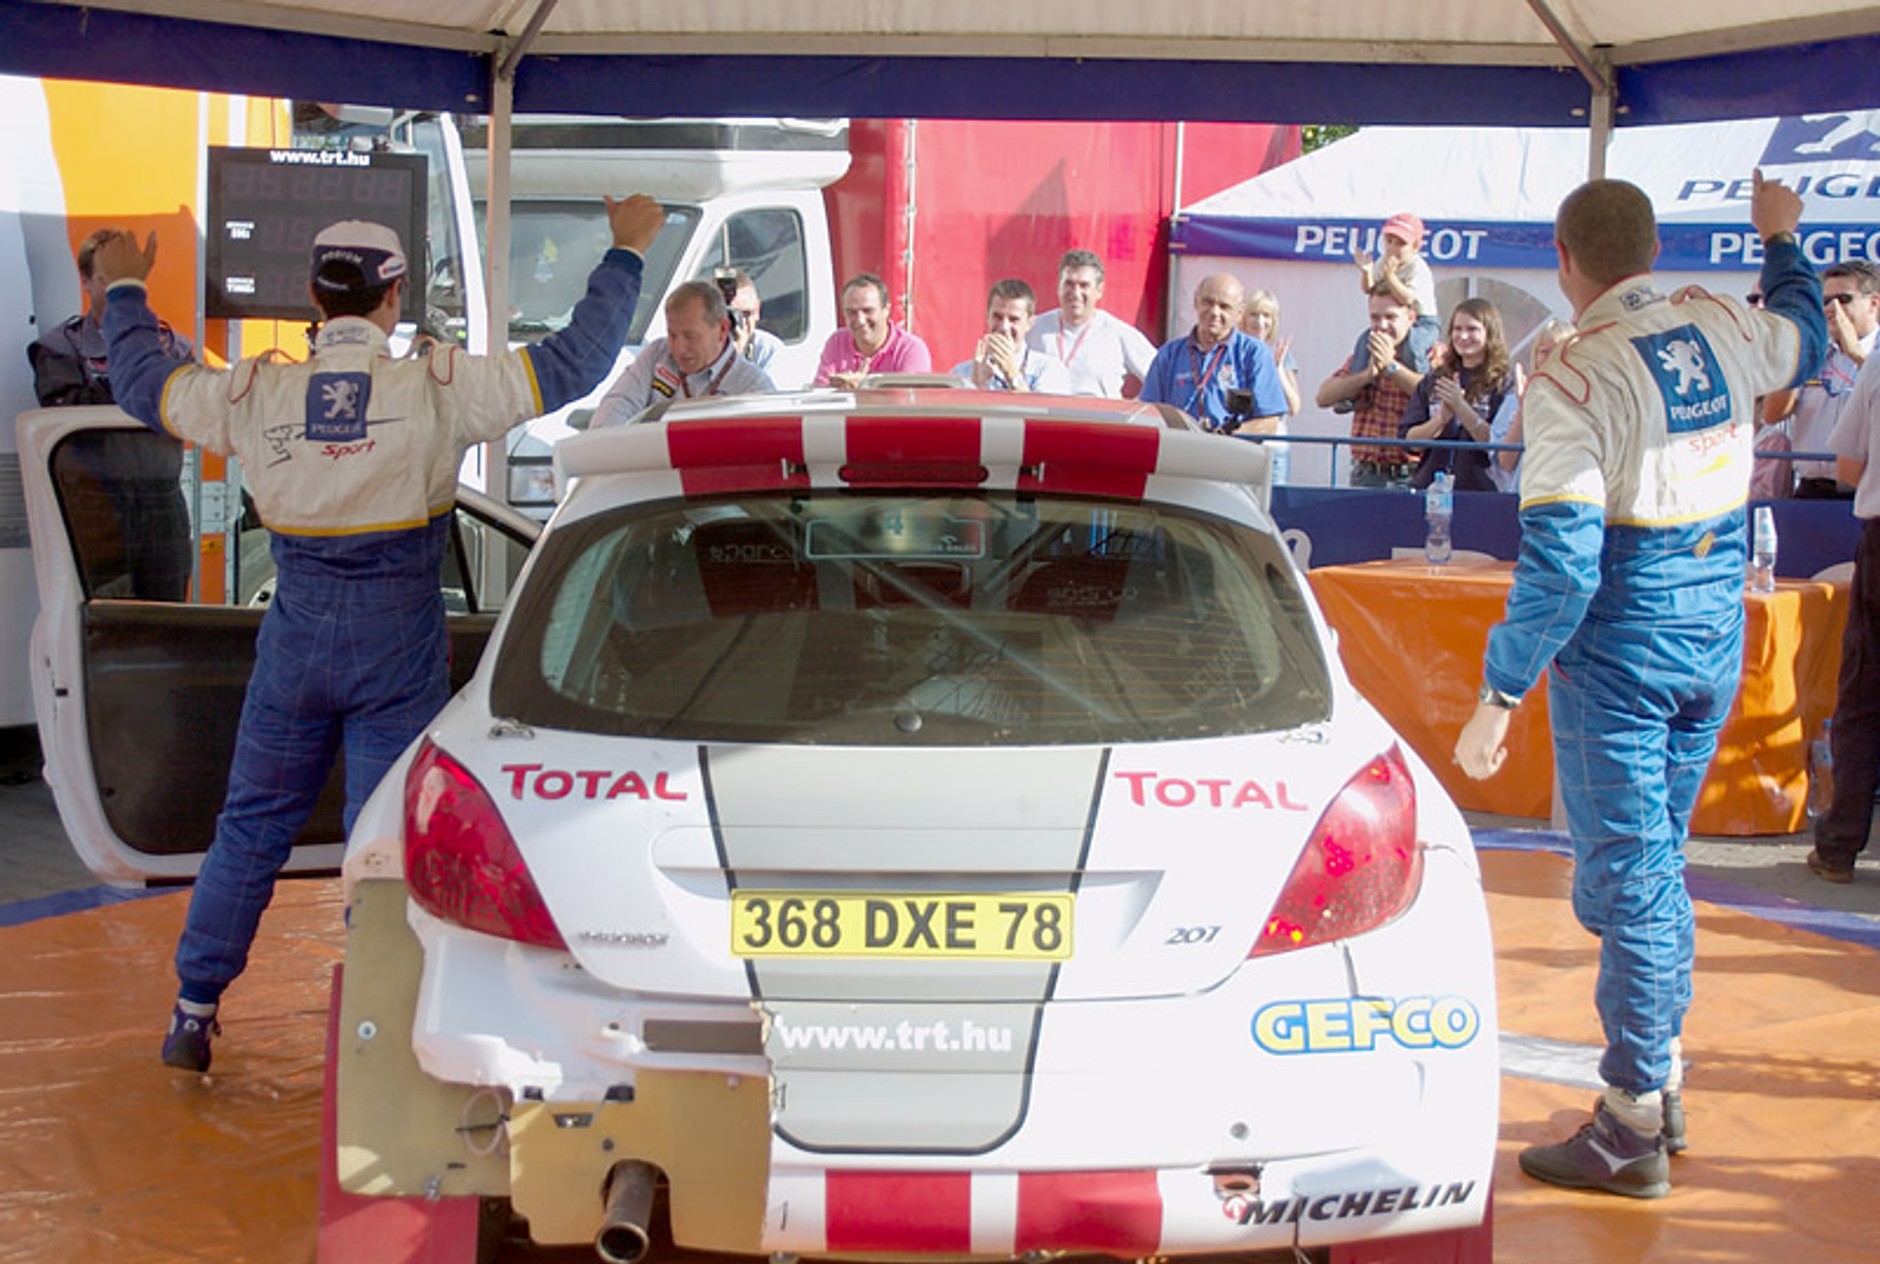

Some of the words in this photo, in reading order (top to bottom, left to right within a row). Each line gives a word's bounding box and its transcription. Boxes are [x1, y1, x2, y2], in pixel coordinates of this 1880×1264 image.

[270, 151, 370, 166] www.trt.hu
[1671, 395, 1728, 420] PEUGEOT
[501, 764, 688, 801] TOTAL
[1114, 772, 1309, 811] TOTAL
[743, 898, 841, 948] 368
[865, 900, 976, 950] DXE
[999, 902, 1063, 952] 78
[778, 1019, 1013, 1052] www.trt.hu
[1251, 995, 1480, 1056] GEFCO
[1238, 1180, 1477, 1226] MICHELIN
